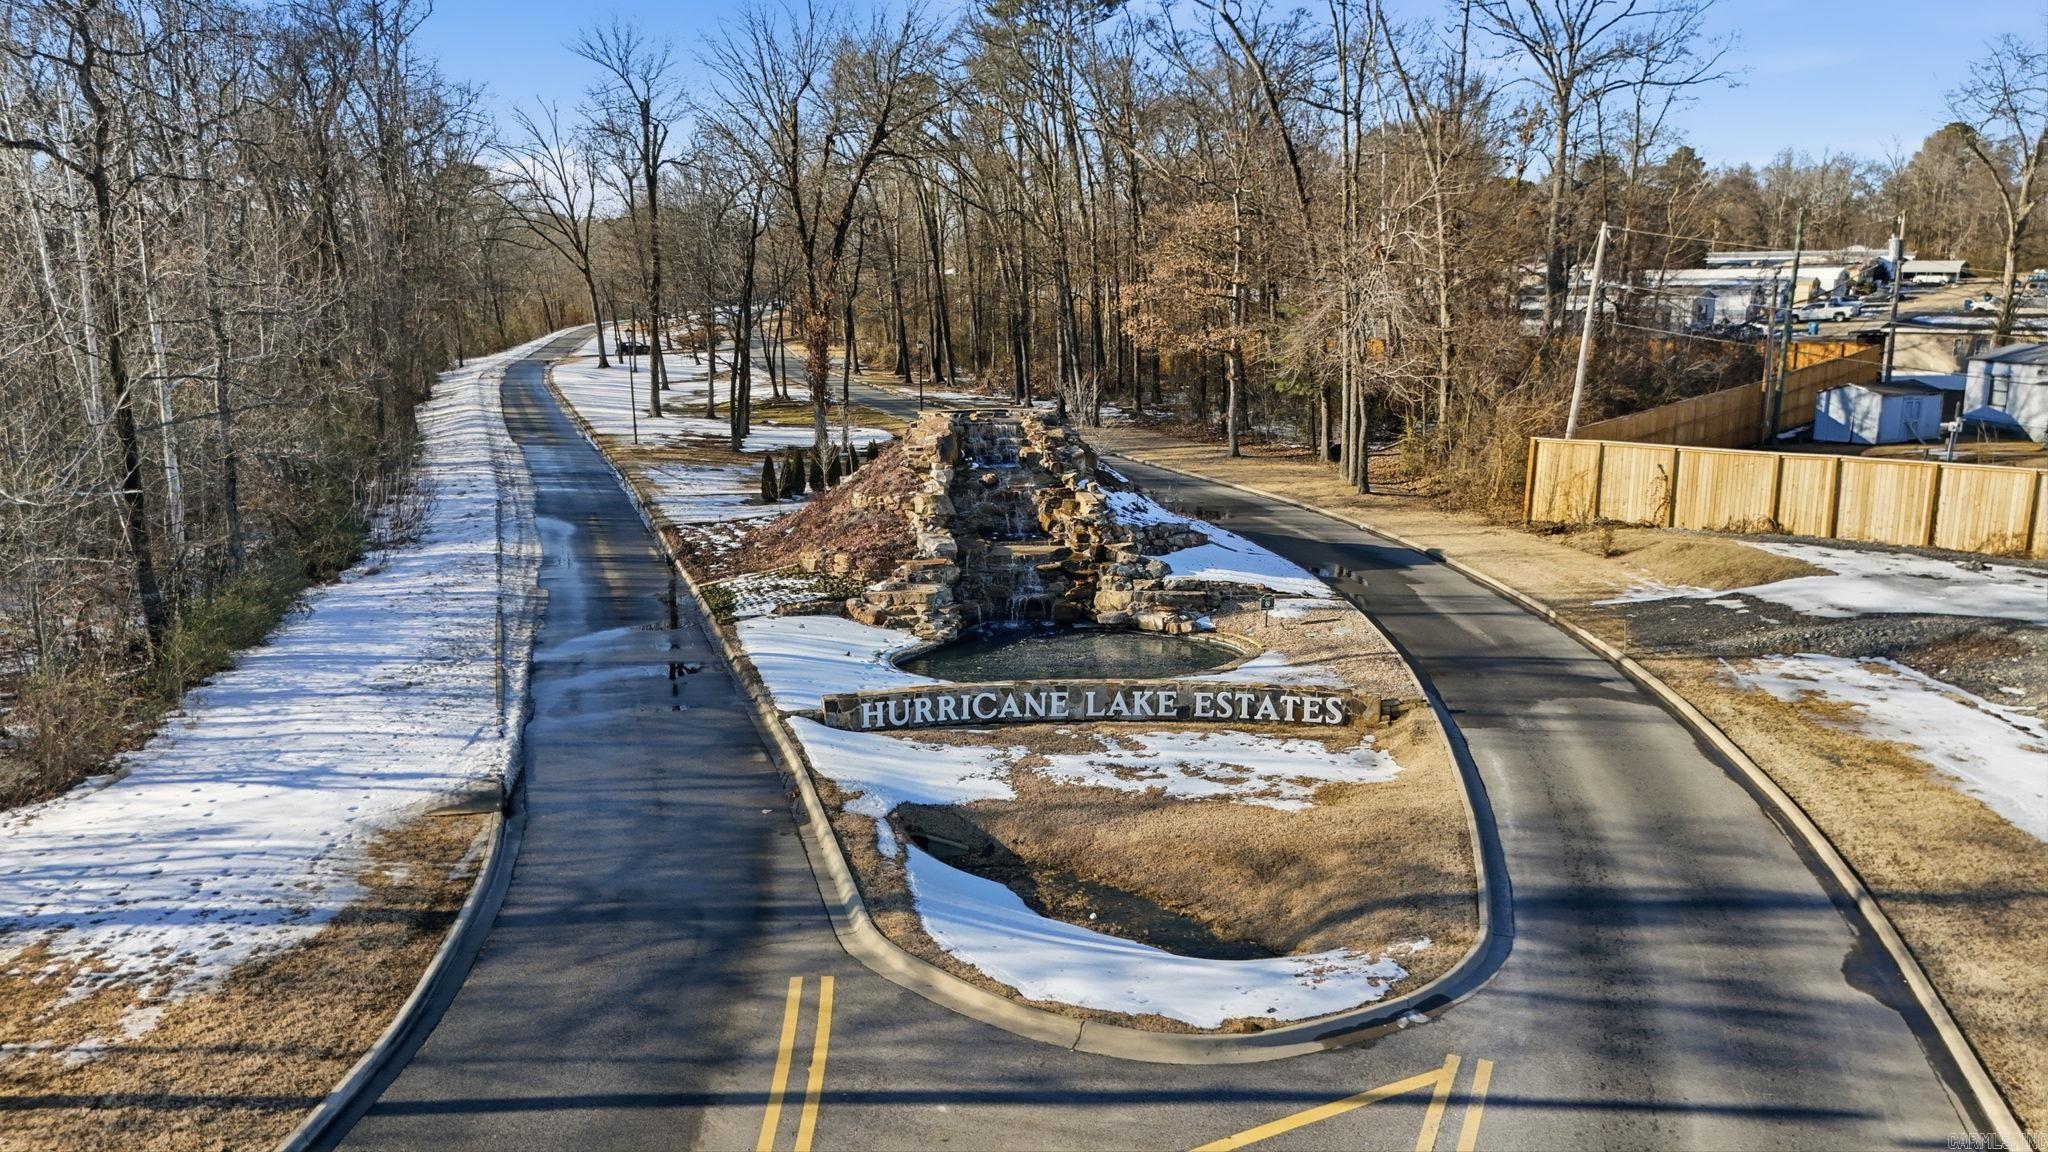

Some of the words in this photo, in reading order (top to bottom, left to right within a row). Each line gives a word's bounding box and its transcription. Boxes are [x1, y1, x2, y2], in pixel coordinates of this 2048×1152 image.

[861, 692, 1069, 728] HURRICANE
[1085, 691, 1177, 717] LAKE
[1194, 692, 1343, 724] ESTATES
